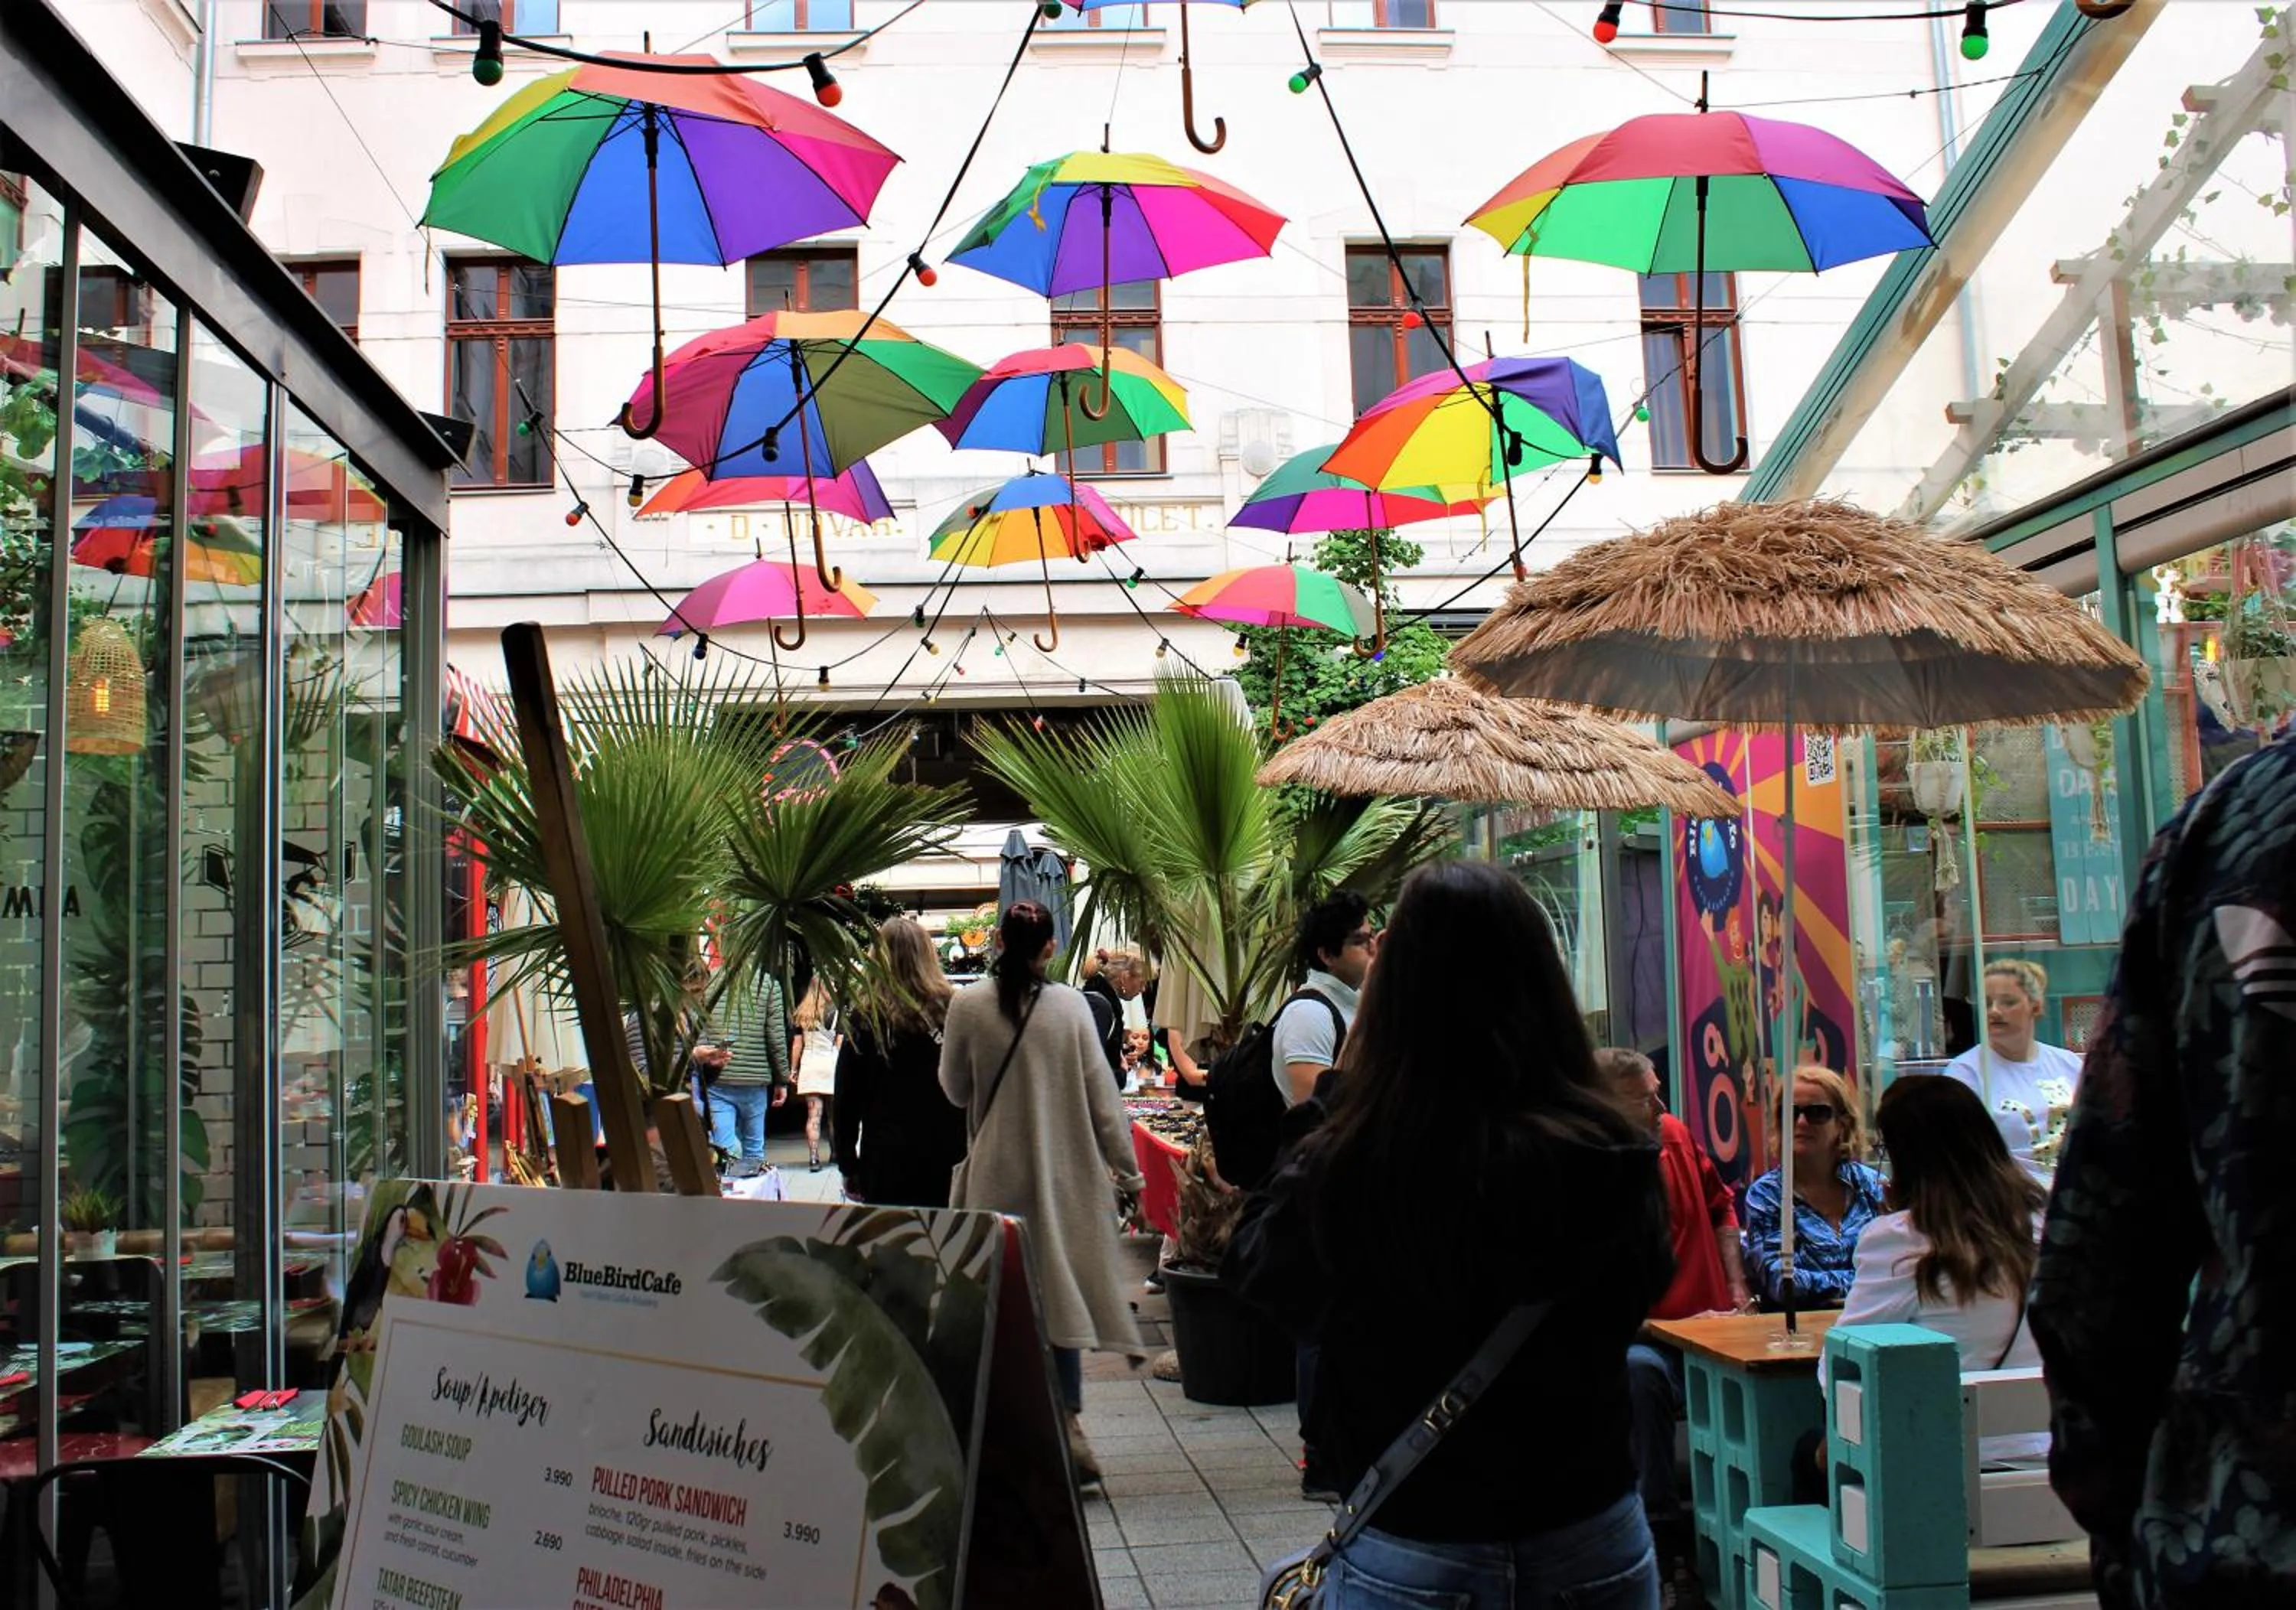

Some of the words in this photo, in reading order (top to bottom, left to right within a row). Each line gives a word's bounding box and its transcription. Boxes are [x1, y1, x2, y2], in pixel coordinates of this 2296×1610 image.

[2062, 875, 2119, 913] DAY
[563, 1261, 682, 1295] BlueBirdCafe
[400, 1423, 444, 1455] GOULASH
[444, 1432, 473, 1462] SOUP
[544, 1466, 573, 1487] 3.990
[391, 1479, 420, 1509] SPICY
[420, 1487, 464, 1520] CHICKEN
[463, 1498, 491, 1530] WING
[591, 1465, 638, 1501] PULLED
[638, 1475, 676, 1511] PORK
[673, 1485, 748, 1528] SANDWICH
[651, 1517, 683, 1537] pulled
[783, 1520, 820, 1546] 3.990
[585, 1521, 625, 1545] cabbage
[625, 1533, 653, 1552] salad
[686, 1546, 708, 1566] fries
[709, 1554, 723, 1569] on
[724, 1557, 742, 1575] the
[377, 1566, 407, 1599] TATAR
[406, 1576, 463, 1610] BEEFSTEAK
[575, 1566, 664, 1610] PHILADELPHIA
